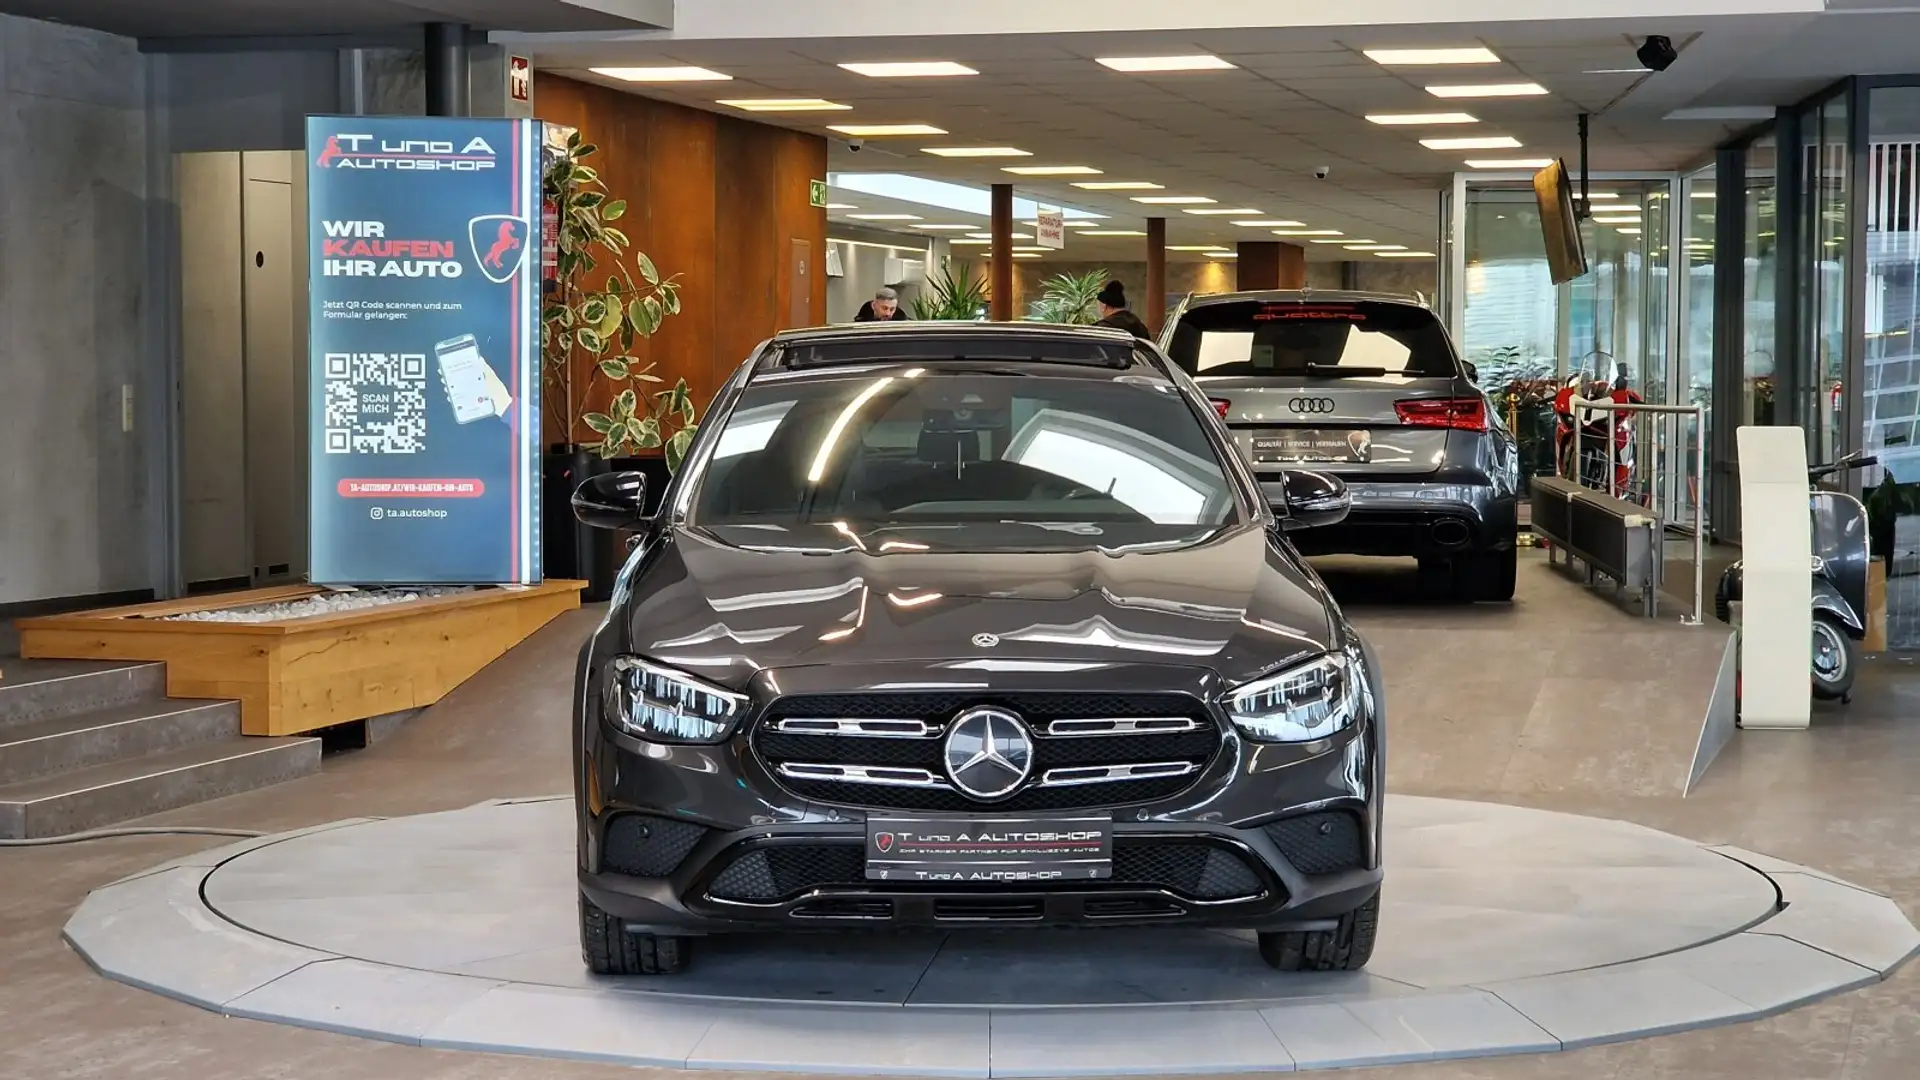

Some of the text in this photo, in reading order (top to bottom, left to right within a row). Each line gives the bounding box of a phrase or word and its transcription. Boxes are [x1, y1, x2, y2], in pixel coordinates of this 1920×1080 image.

[336, 133, 373, 151] T
[460, 136, 496, 154] A
[336, 158, 496, 171] AUTOSHOP
[321, 220, 385, 238] WIR
[323, 239, 454, 258] KAUFEN
[323, 259, 463, 278] IHR AUTO
[323, 301, 344, 309] Jetzt
[345, 301, 360, 310] QR
[361, 301, 384, 309] Code
[424, 302, 441, 310] und
[323, 311, 408, 320] Formular gelangen:
[1253, 311, 1367, 320] quattro
[362, 394, 389, 403] SCAN
[362, 404, 389, 413] MICH
[386, 508, 448, 518] ta.autoshop
[897, 832, 912, 840] T
[956, 833, 971, 841] A
[978, 831, 1102, 842] AUTOSHOP
[969, 871, 1062, 880] AUTOSHOP
